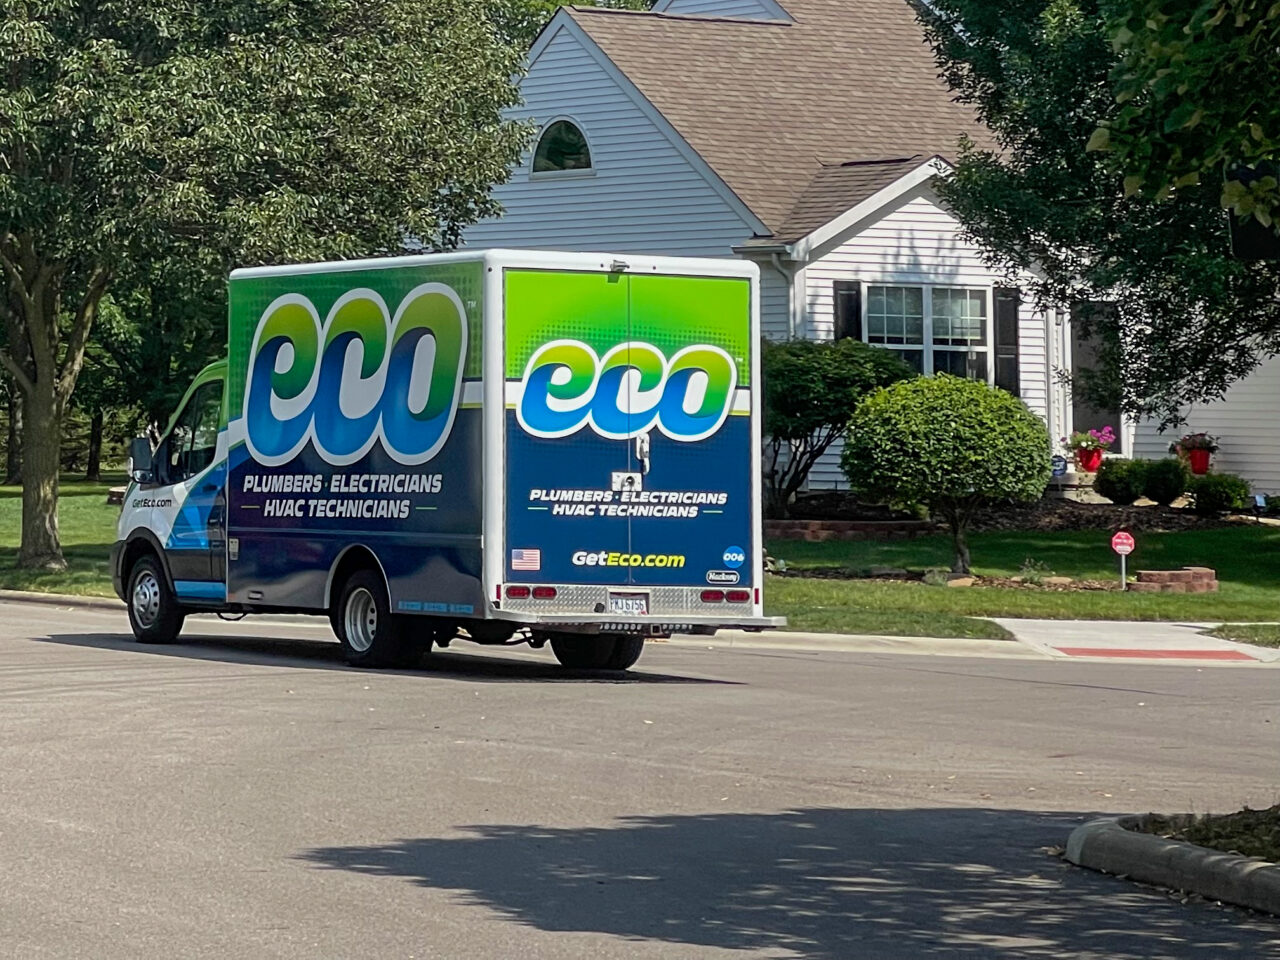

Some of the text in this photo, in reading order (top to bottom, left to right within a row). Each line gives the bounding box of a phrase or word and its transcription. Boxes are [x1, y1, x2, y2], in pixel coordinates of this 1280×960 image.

[244, 286, 466, 463] eco
[518, 342, 734, 439] eco
[243, 474, 443, 493] PLUMBERS ELECTRICIANS
[132, 498, 172, 508] GetEco.com
[529, 489, 728, 505] PLUMBERS ELECTRICIANS
[263, 499, 410, 518] HVAC TECHNICIANS
[552, 504, 699, 518] HVAC TECHNICIANS
[572, 551, 686, 568] GetEco.com
